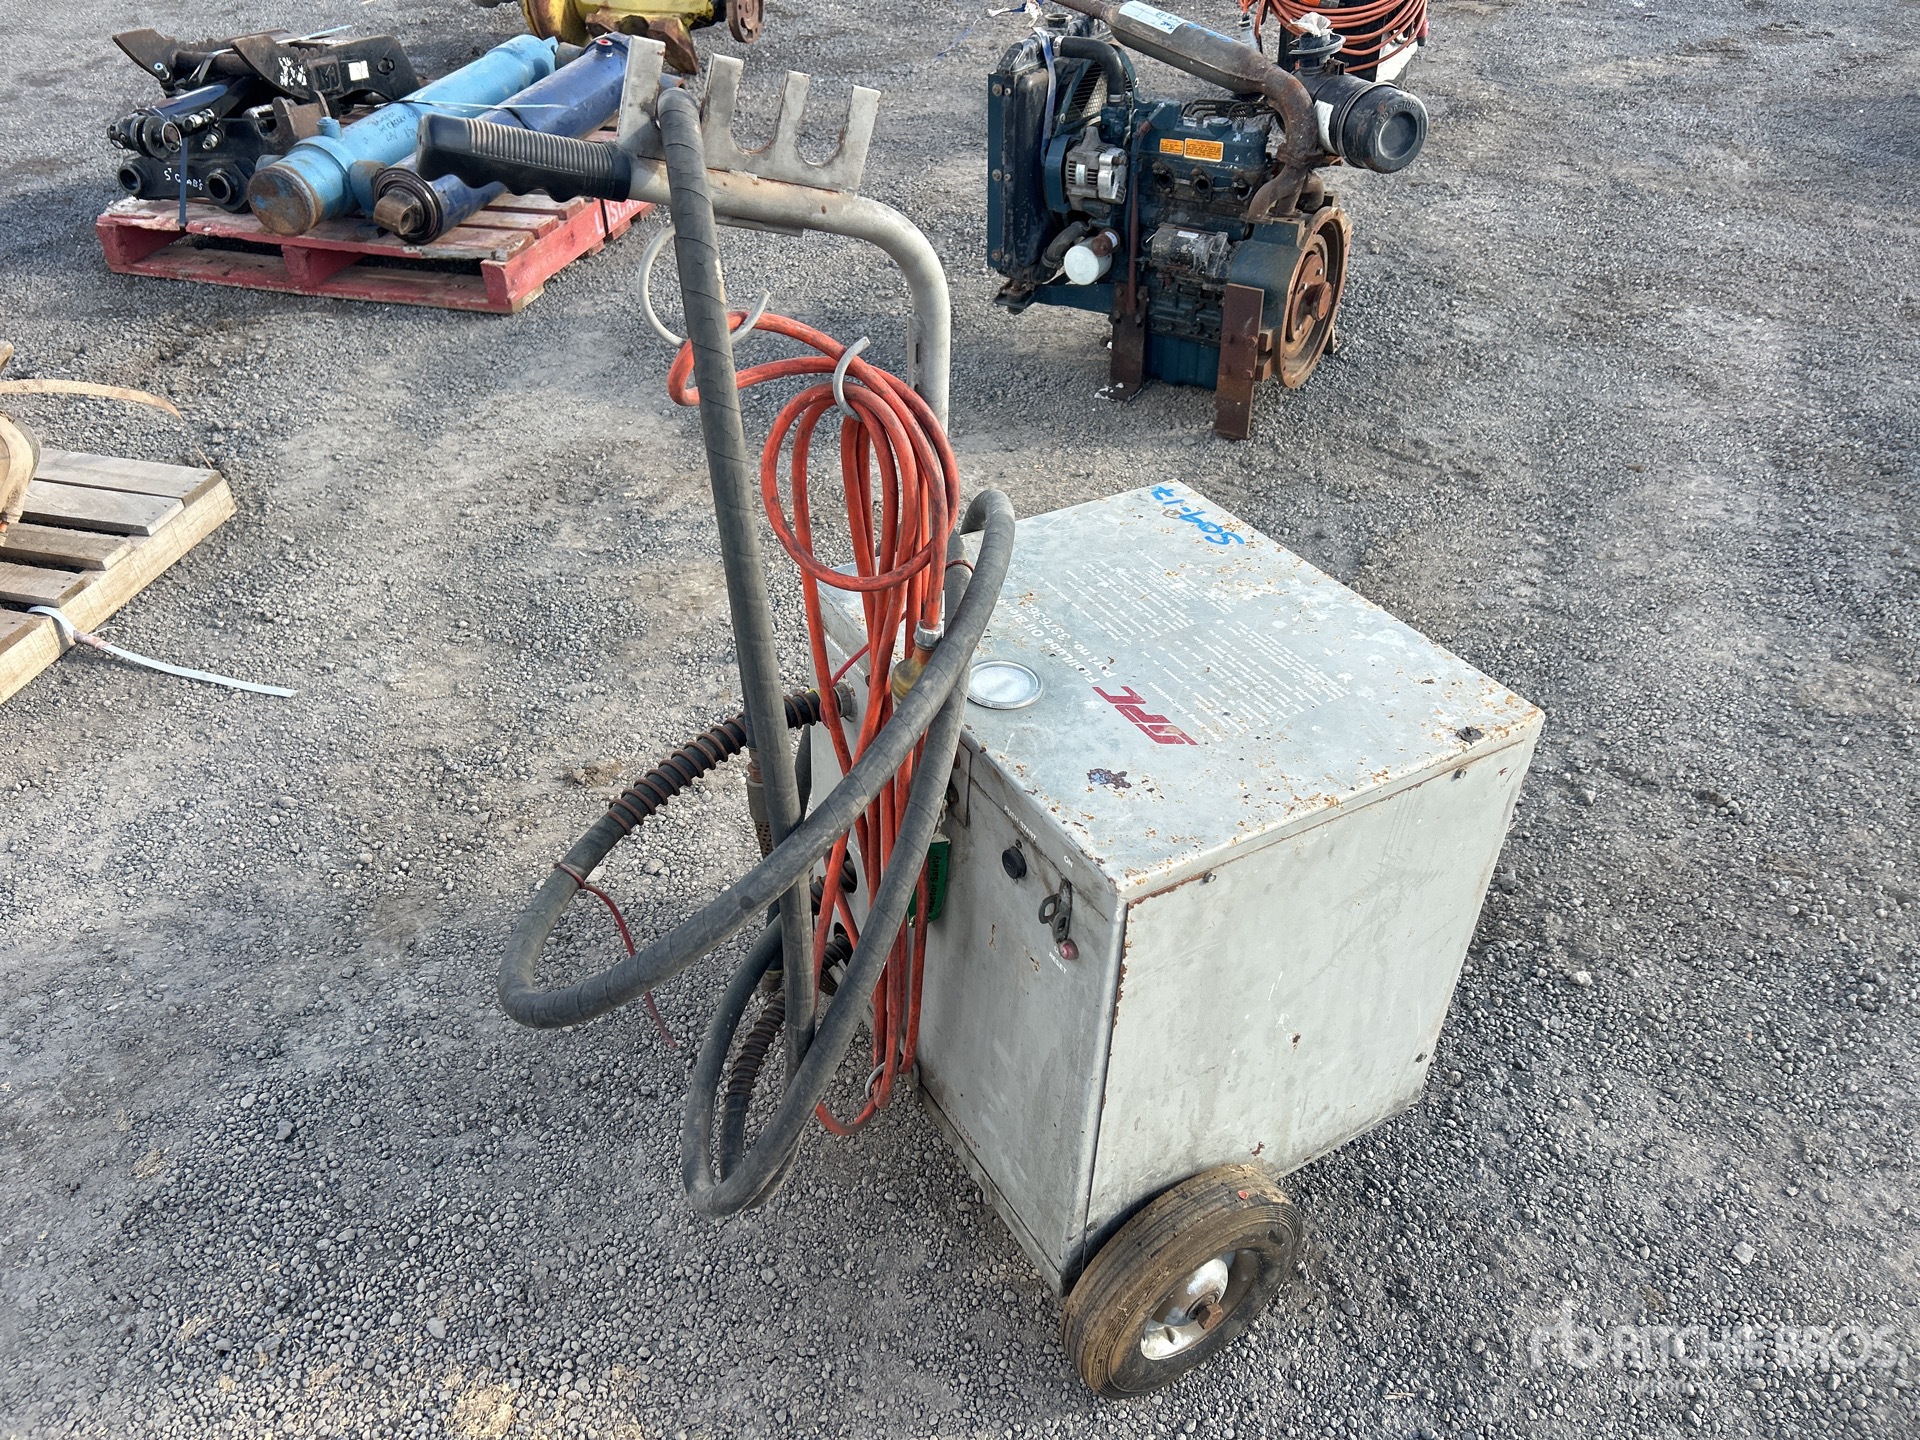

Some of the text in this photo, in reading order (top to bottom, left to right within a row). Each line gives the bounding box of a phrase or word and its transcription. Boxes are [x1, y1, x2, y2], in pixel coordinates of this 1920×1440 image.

[593, 199, 642, 236] LSCA
[1022, 622, 1046, 637] Oil
[1066, 640, 1092, 656] no.
[1084, 655, 1118, 678] Part
[1004, 805, 1037, 841] PUSH START
[1063, 855, 1074, 868] ON
[1048, 952, 1068, 974] RESET
